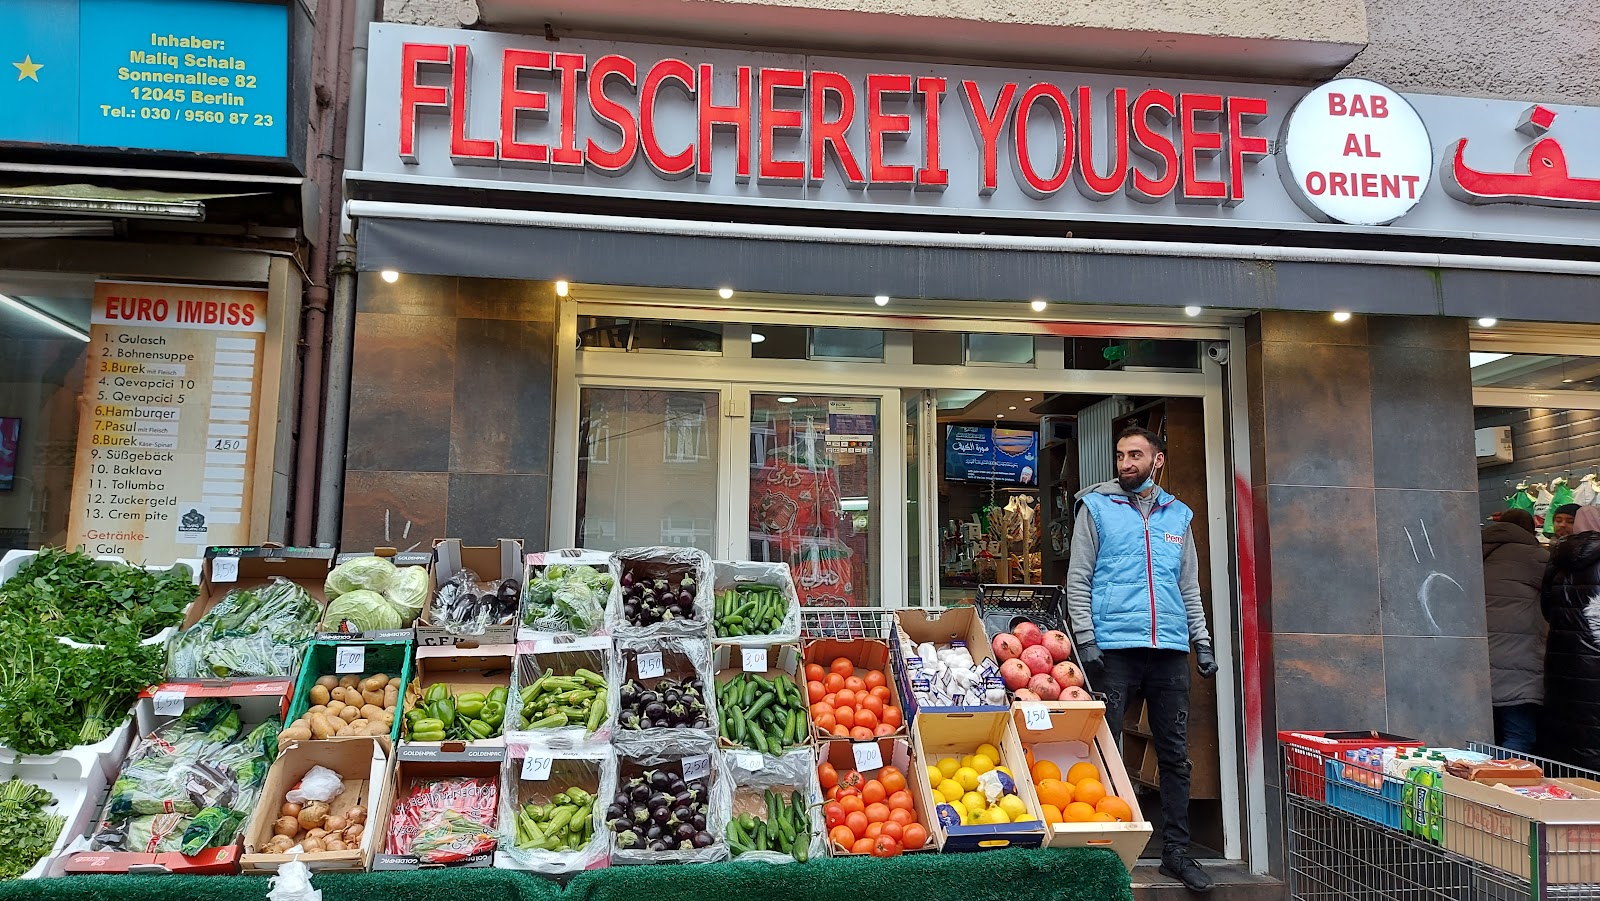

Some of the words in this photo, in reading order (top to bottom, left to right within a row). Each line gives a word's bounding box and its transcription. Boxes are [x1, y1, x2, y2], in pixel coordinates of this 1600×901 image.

[151, 33, 225, 50] Inhaber:
[130, 50, 178, 69] Maliq
[184, 53, 246, 71] Schala
[118, 67, 229, 87] Sonnenallee
[235, 75, 257, 89] 82
[130, 87, 185, 102] 12045
[191, 90, 244, 106] Berlin
[1328, 93, 1388, 118] BAB
[100, 104, 136, 118] Tel.:
[140, 107, 170, 120] 030
[175, 110, 180, 120] /
[184, 110, 225, 124] 9560
[229, 113, 249, 125] 87
[253, 114, 273, 127] 23
[399, 42, 949, 189] FLEISCHEREI
[963, 82, 1268, 202] YOUSEF
[1343, 133, 1381, 158] AL
[1305, 171, 1420, 199] ORIENT
[105, 296, 169, 322] EURO
[176, 300, 255, 326] IMBISS
[105, 333, 114, 343] 1.
[118, 333, 166, 345] Gulasch
[102, 347, 112, 357] 2.
[117, 348, 194, 362] Bohnensuppe
[98, 376, 109, 386] 4.
[114, 377, 174, 389] Qevapcici
[180, 379, 195, 389] 10
[97, 390, 107, 400] 5.
[112, 391, 173, 404] Qevapcici
[177, 394, 185, 403] 5
[90, 449, 101, 460] 9.
[106, 449, 174, 462] Süßgebäck
[90, 464, 108, 474] 10.
[113, 465, 162, 476] Baklava
[88, 478, 107, 489] 11.
[112, 480, 165, 491] Tollumba
[87, 493, 105, 504] 12.
[110, 494, 177, 507] Zuckergeld
[85, 508, 103, 519] 13.
[108, 509, 140, 520] Crem
[144, 511, 168, 522] pite
[82, 529, 149, 541] -Getränke-
[96, 544, 125, 554] Cola
[639, 658, 661, 675] 2,50
[745, 652, 765, 668] 3,00
[1027, 709, 1046, 726] 1,50
[525, 756, 551, 773] 3,50
[855, 749, 877, 766] 2,00
[683, 759, 709, 775] 2,50
